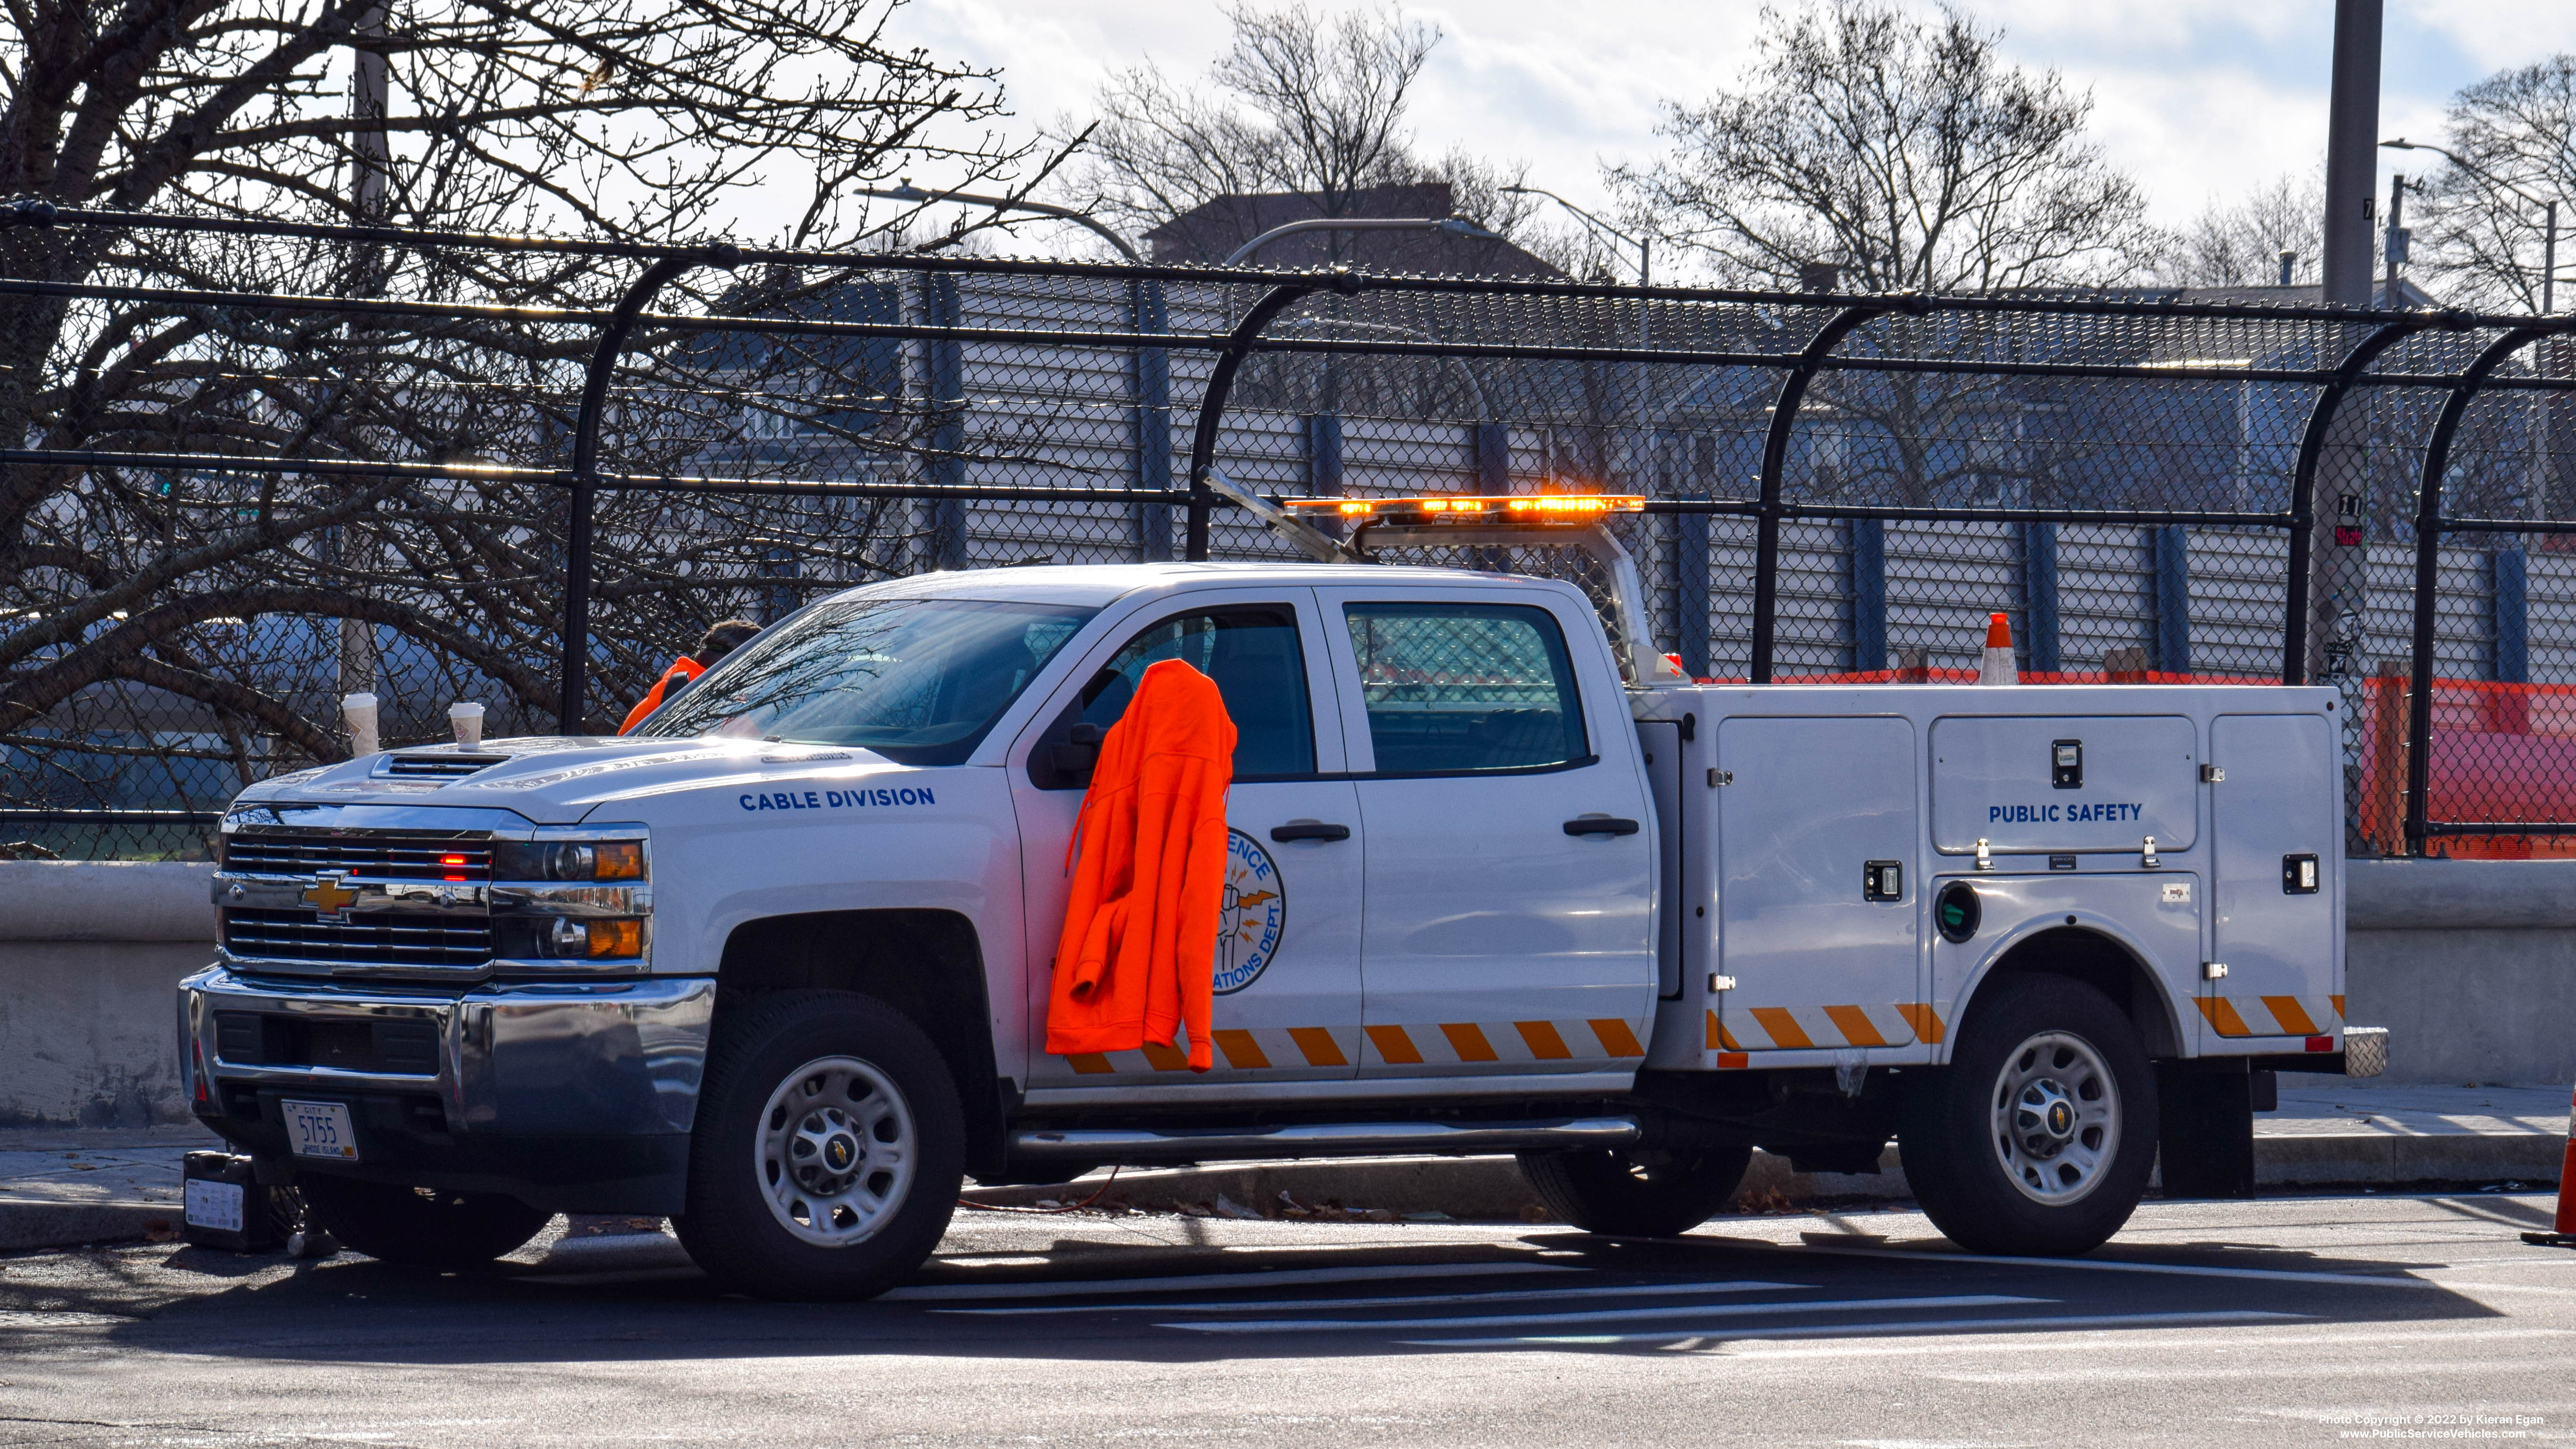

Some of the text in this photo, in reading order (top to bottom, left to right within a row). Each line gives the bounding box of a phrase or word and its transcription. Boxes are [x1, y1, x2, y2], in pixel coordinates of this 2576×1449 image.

[2366, 200, 2372, 218] 7
[739, 788, 936, 811] CABLE DIVISION
[1989, 803, 2143, 823] PUBLIC SAFETY
[1259, 900, 1280, 954] DEPT.
[304, 1107, 321, 1115] CITY
[298, 1115, 336, 1143] 5755
[304, 1144, 340, 1155] RHODE ISLAND
